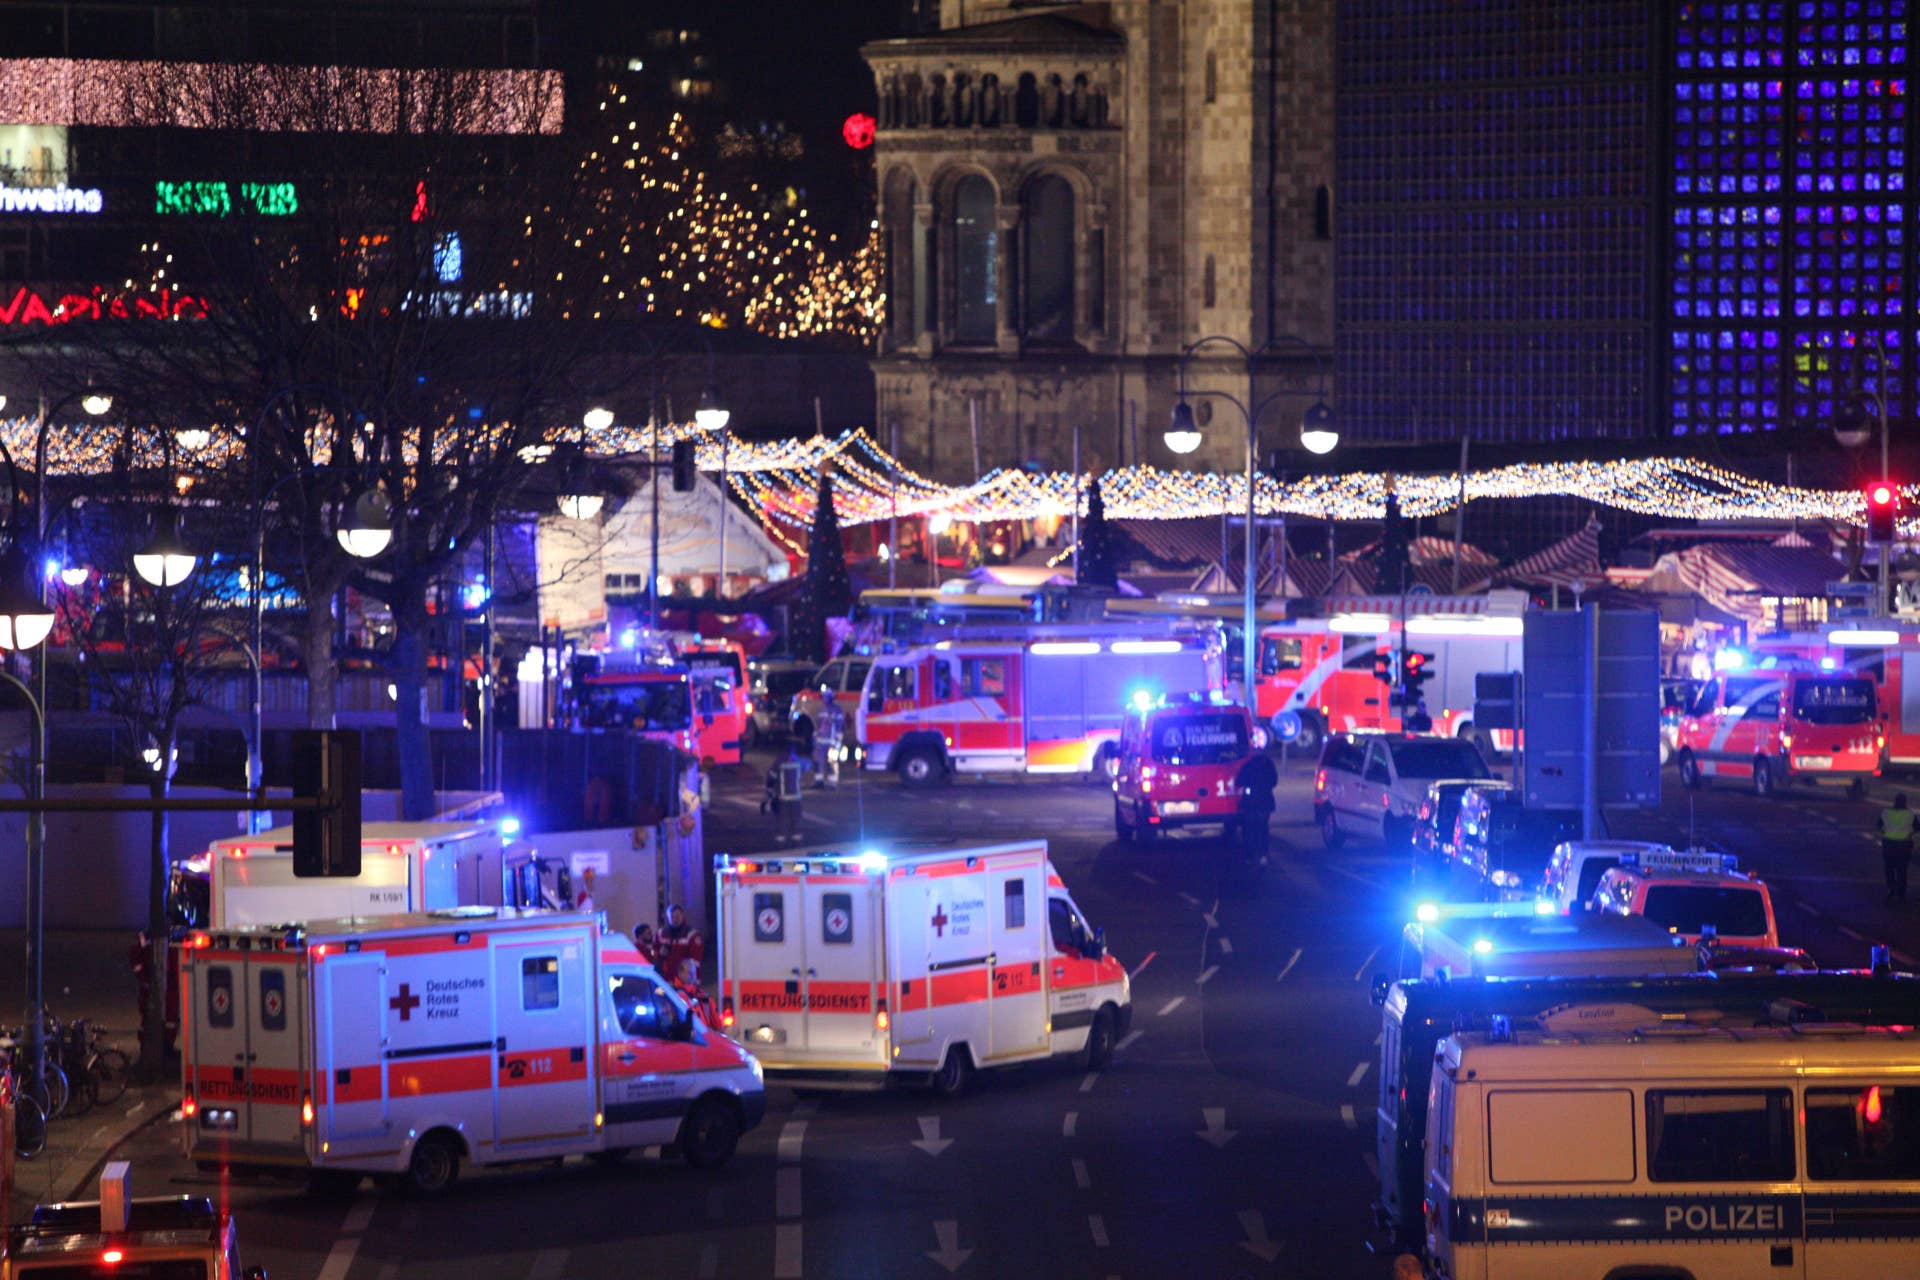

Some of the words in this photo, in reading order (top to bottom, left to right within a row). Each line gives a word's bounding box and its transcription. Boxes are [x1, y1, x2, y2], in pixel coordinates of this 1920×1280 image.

[1848, 738, 1874, 754] 112
[1216, 778, 1241, 797] 11
[1645, 854, 1713, 866] FEUERWEHR
[426, 977, 485, 992] Deutsches
[426, 993, 459, 1006] Rotes
[742, 993, 868, 1009] RETTUNGSDIENST
[427, 1007, 459, 1020] Kreuz
[530, 1056, 553, 1074] 112
[200, 1080, 298, 1099] RETTUNGSDIENST
[1664, 1205, 1784, 1232] POLIZEI
